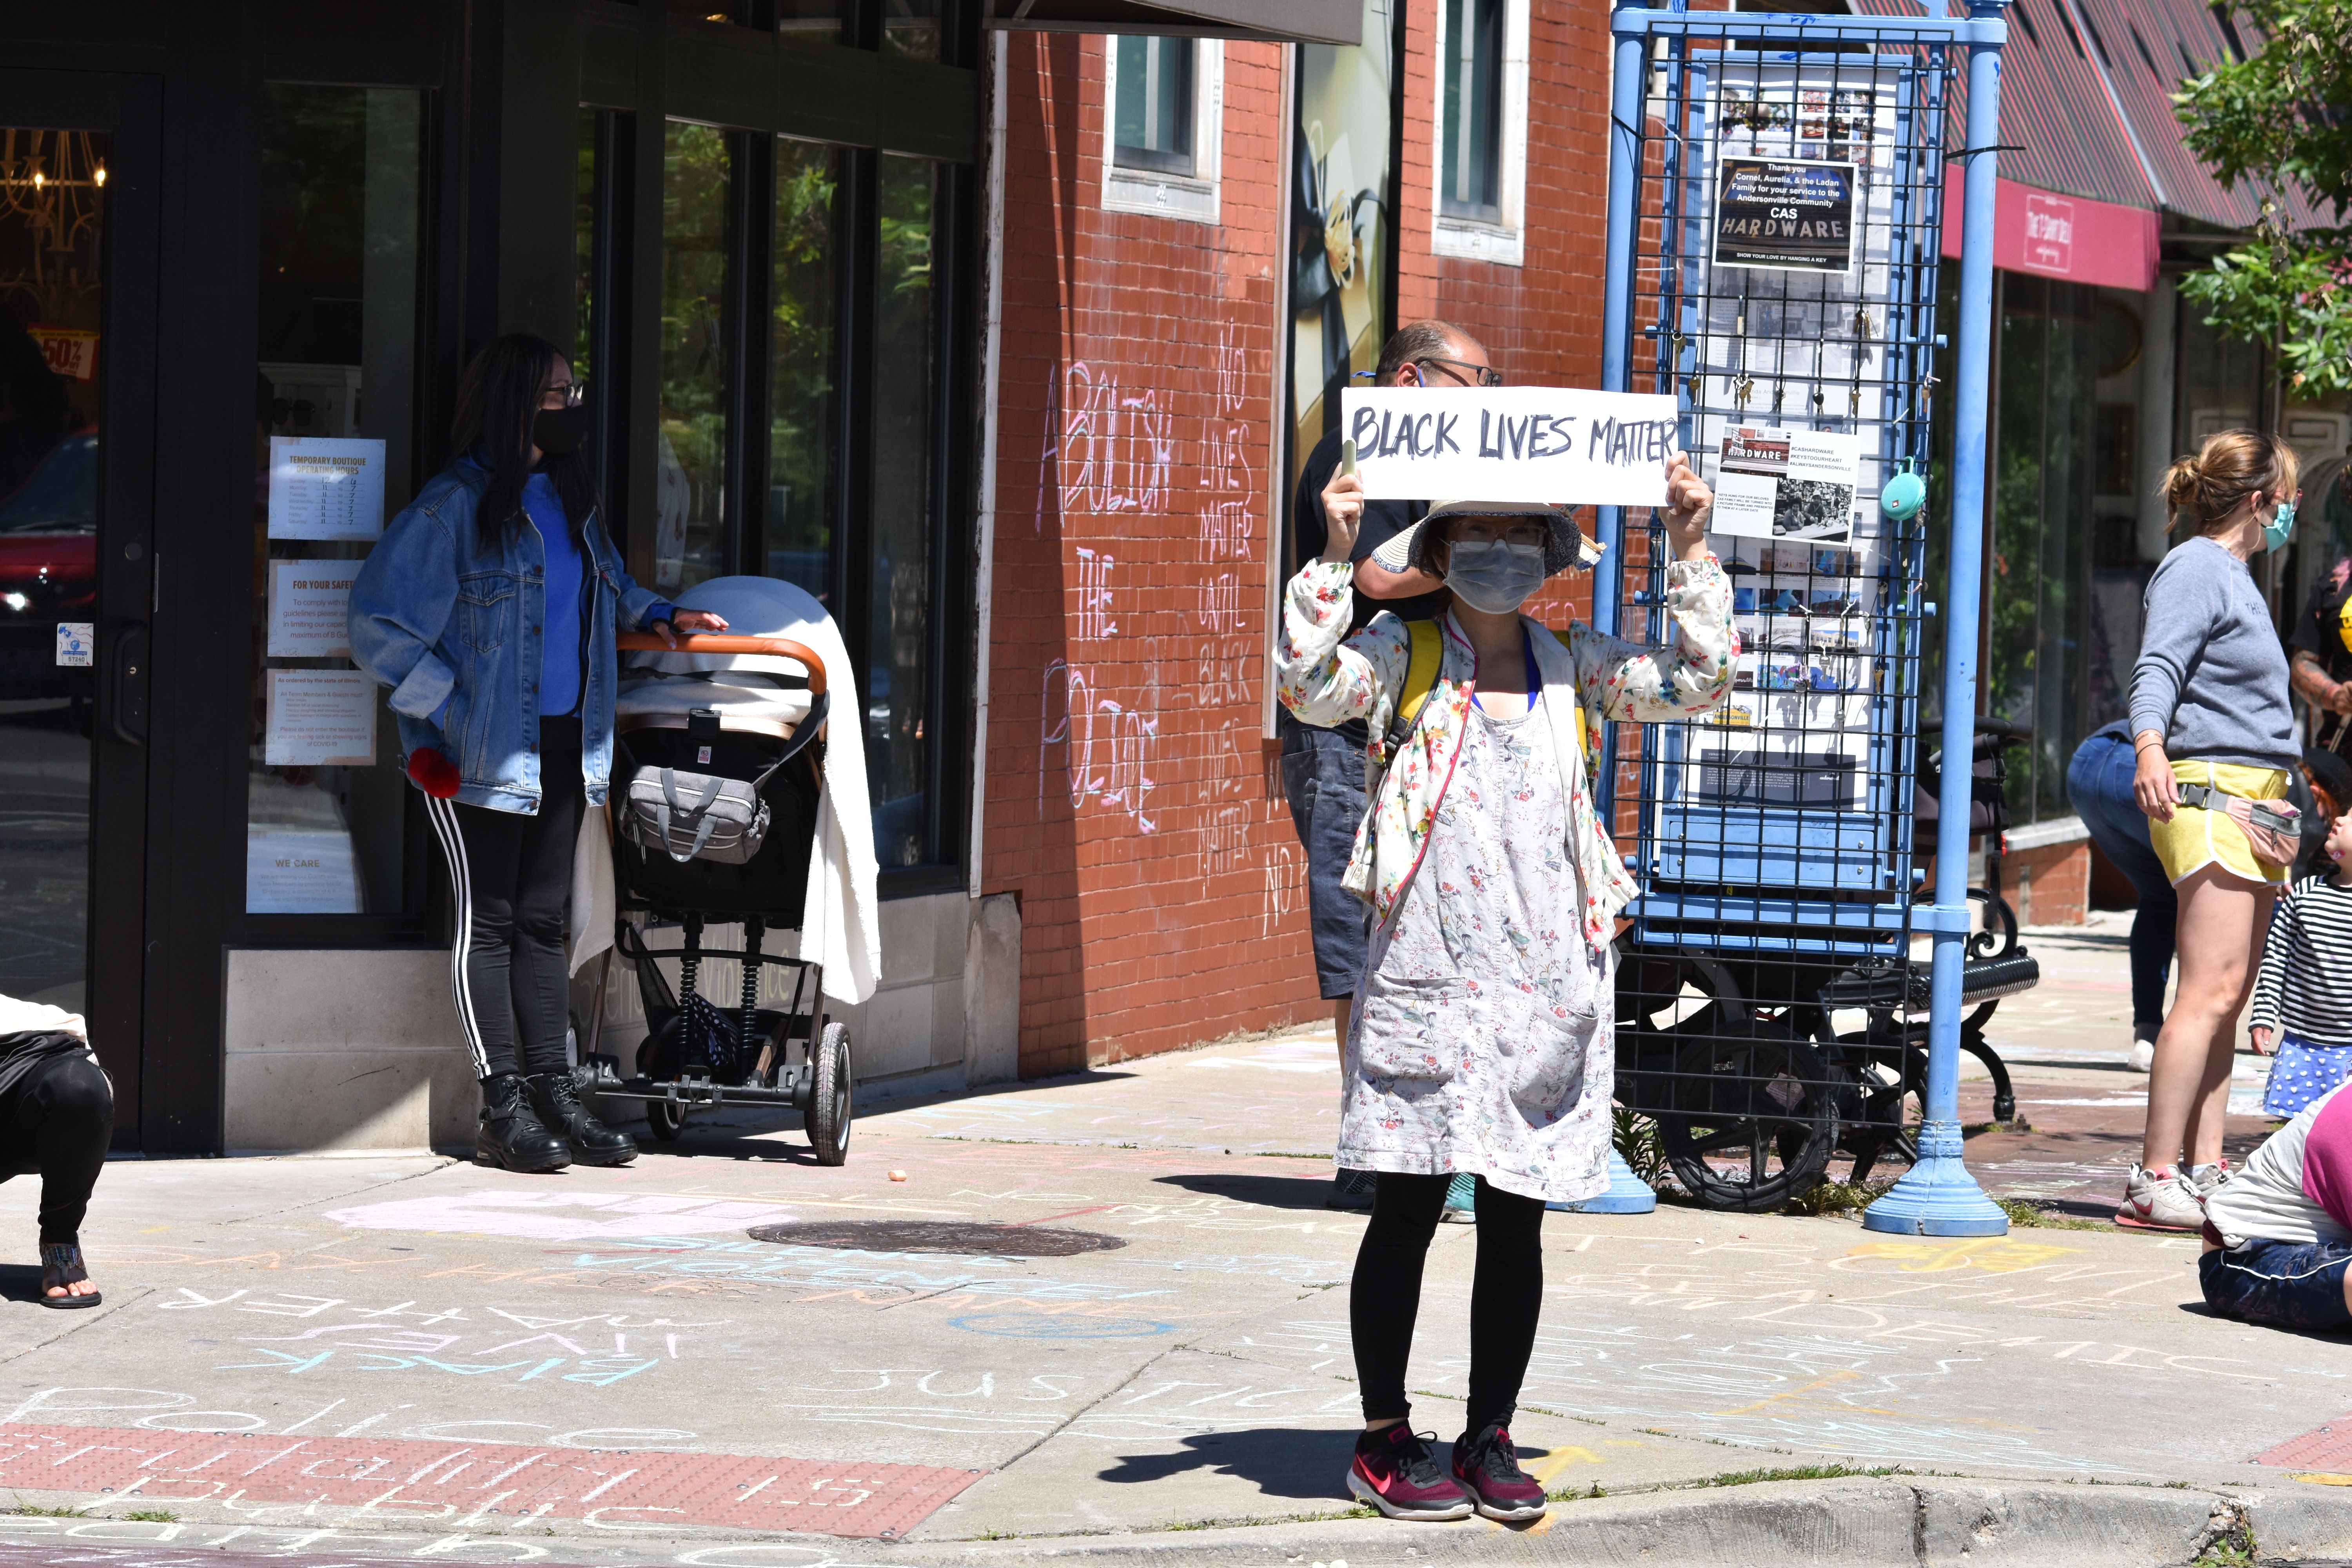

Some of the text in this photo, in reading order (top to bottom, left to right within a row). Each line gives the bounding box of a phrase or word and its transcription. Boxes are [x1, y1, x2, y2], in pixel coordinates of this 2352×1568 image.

[1792, 165, 1806, 174] you
[1736, 174, 1762, 182] Cornel,
[1764, 176, 1792, 184] Aurelia,
[1816, 178, 1839, 187] Ladan
[1732, 184, 1756, 192] Family
[1770, 186, 1788, 194] your
[1789, 187, 1816, 195] service
[1737, 194, 1833, 207] Andersonville Community
[1771, 208, 1797, 219] CAS
[1721, 218, 1844, 238] HARDWARE
[1216, 317, 1245, 416] NO
[1352, 406, 1678, 467] BLACK LIVES MATTER
[290, 456, 366, 466] TEMPORARY BOUTIQUE
[1200, 419, 1252, 507] LIVES
[1789, 462, 1851, 471] #ALWAYSANDERSONVILLE
[1790, 454, 1842, 463] #KEYSTOOURHEART
[1200, 499, 1252, 564] MATTER
[293, 581, 353, 590] FOR YOUR SAFET
[1077, 546, 1118, 640] THE
[1199, 573, 1245, 638] UNTIL
[1106, 1215, 1368, 1235] PEAC
[610, 1236, 1038, 1267] SILENCE
